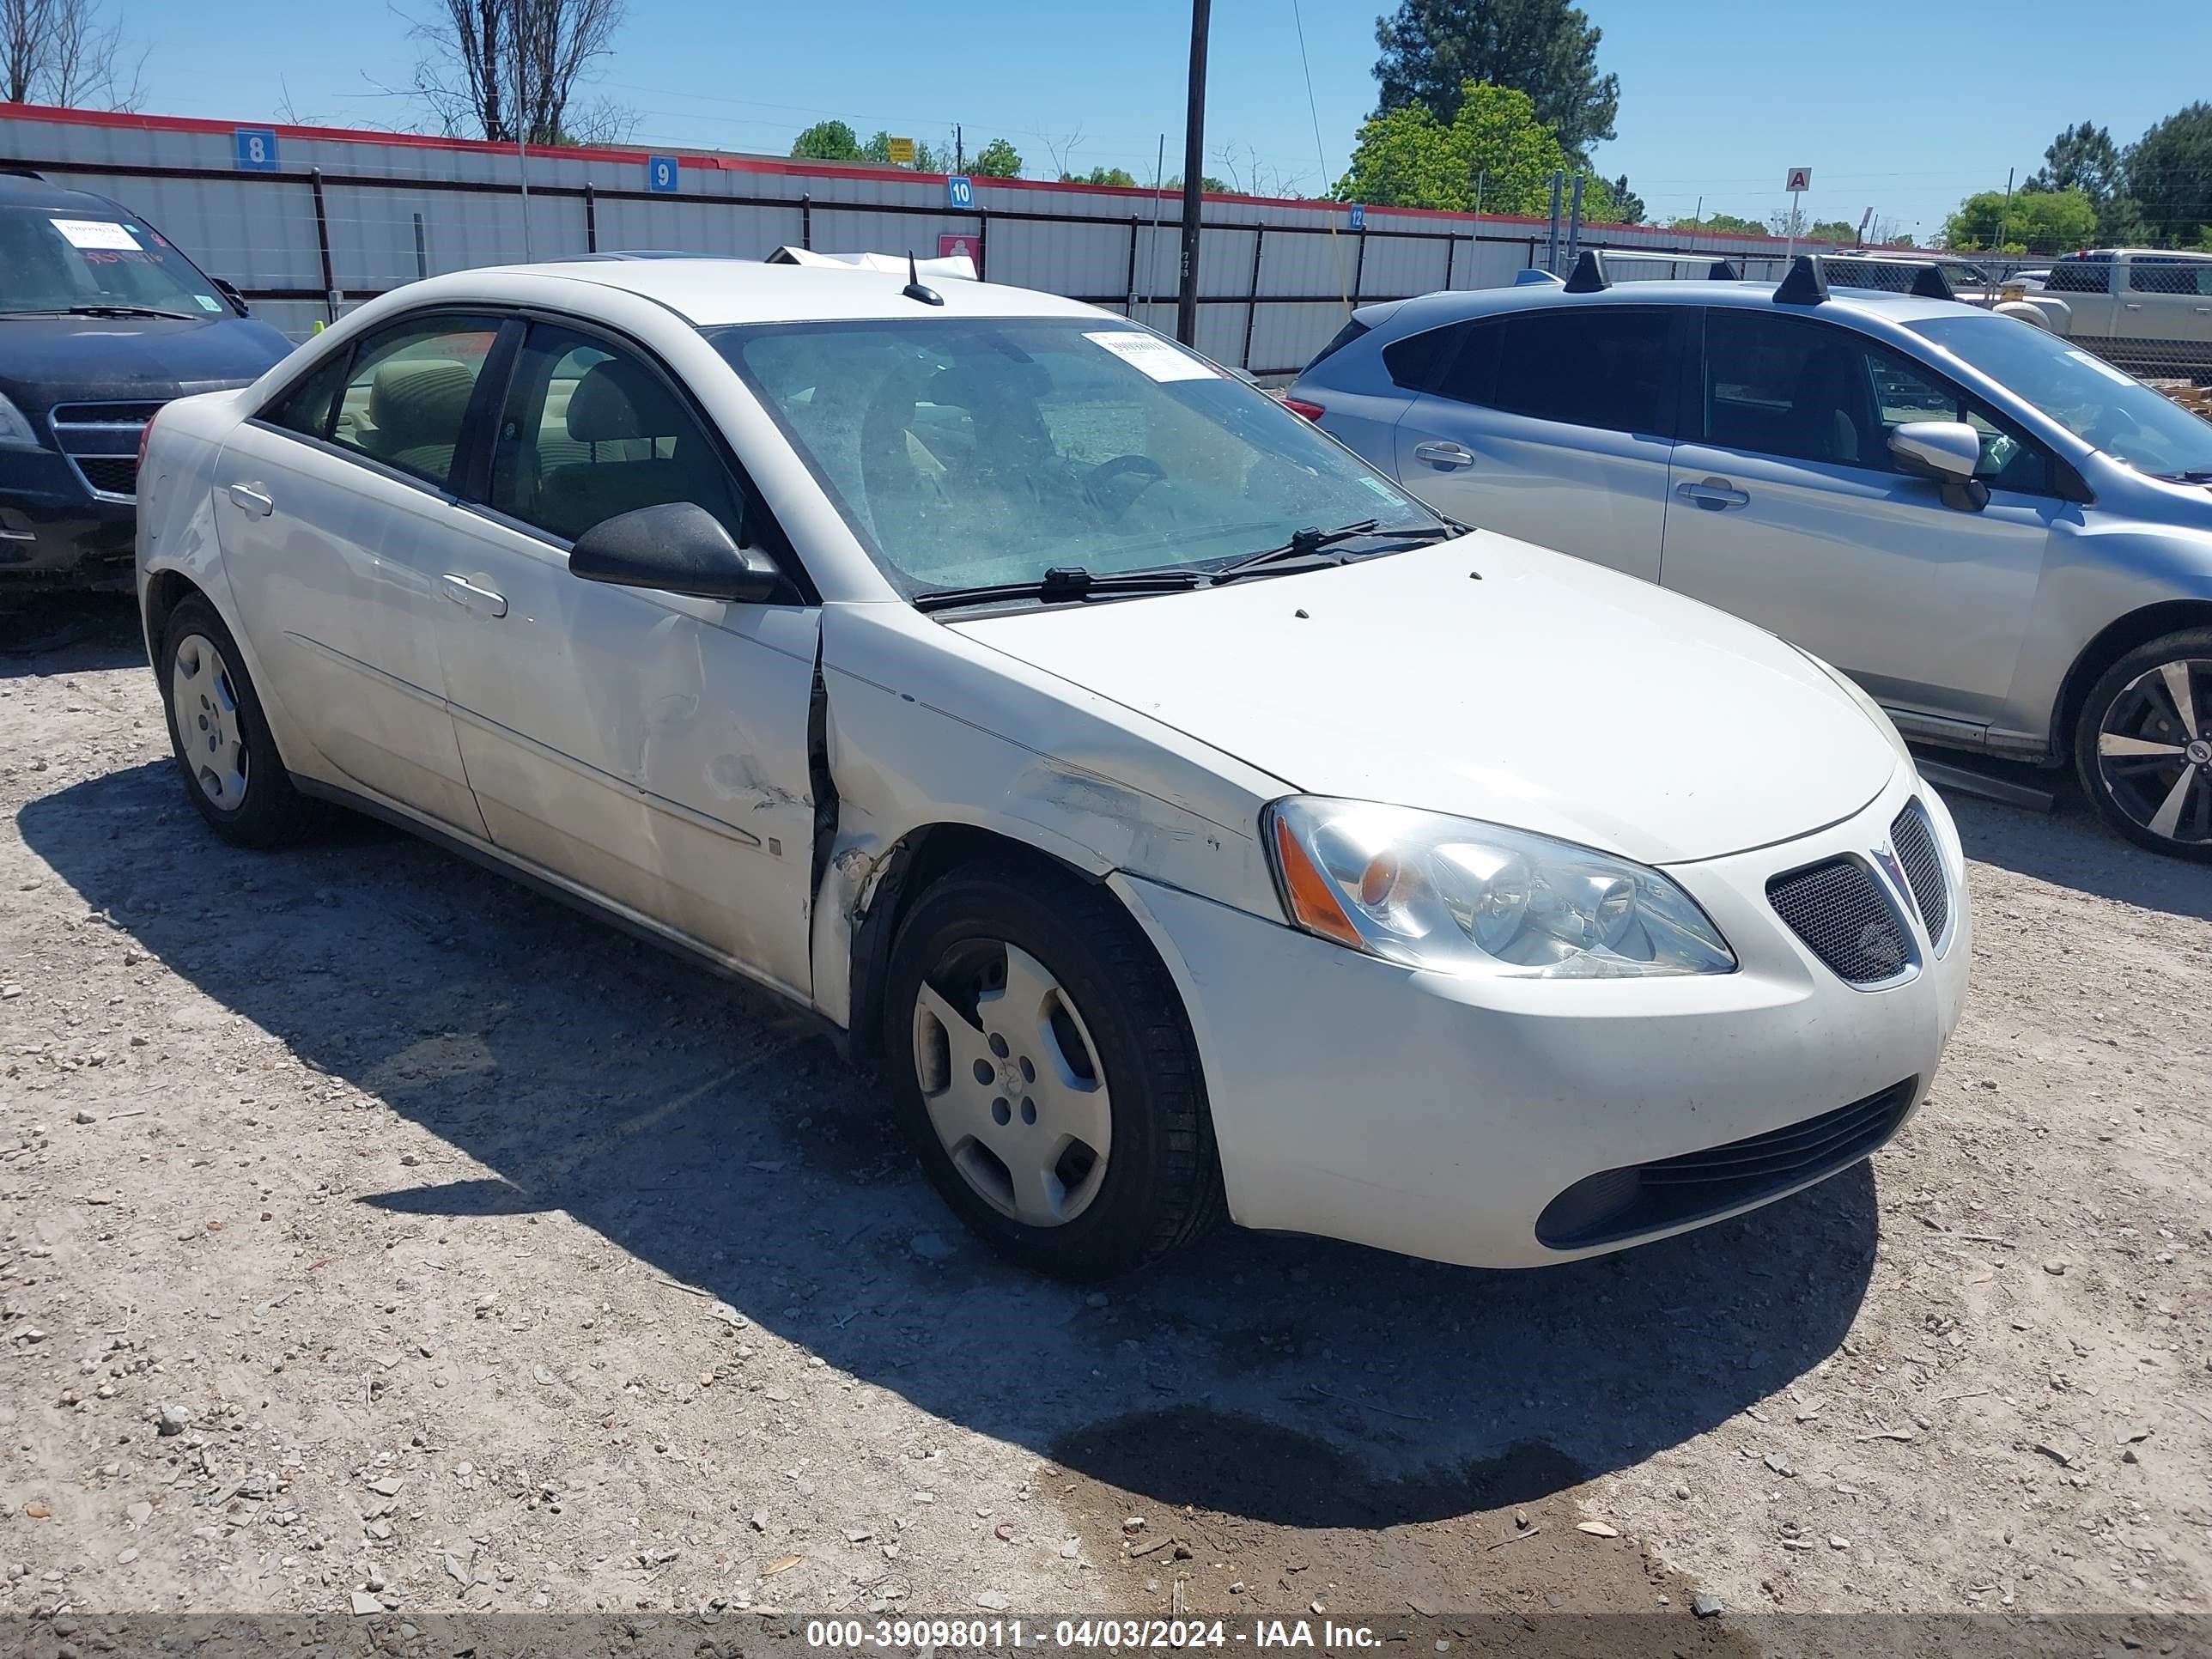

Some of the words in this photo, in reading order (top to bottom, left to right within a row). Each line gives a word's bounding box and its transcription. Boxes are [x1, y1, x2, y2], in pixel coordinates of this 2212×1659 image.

[249, 137, 265, 163] 8
[657, 163, 670, 186] 9
[1790, 172, 1805, 187] A
[953, 183, 969, 203] 10
[1352, 210, 1362, 225] 12
